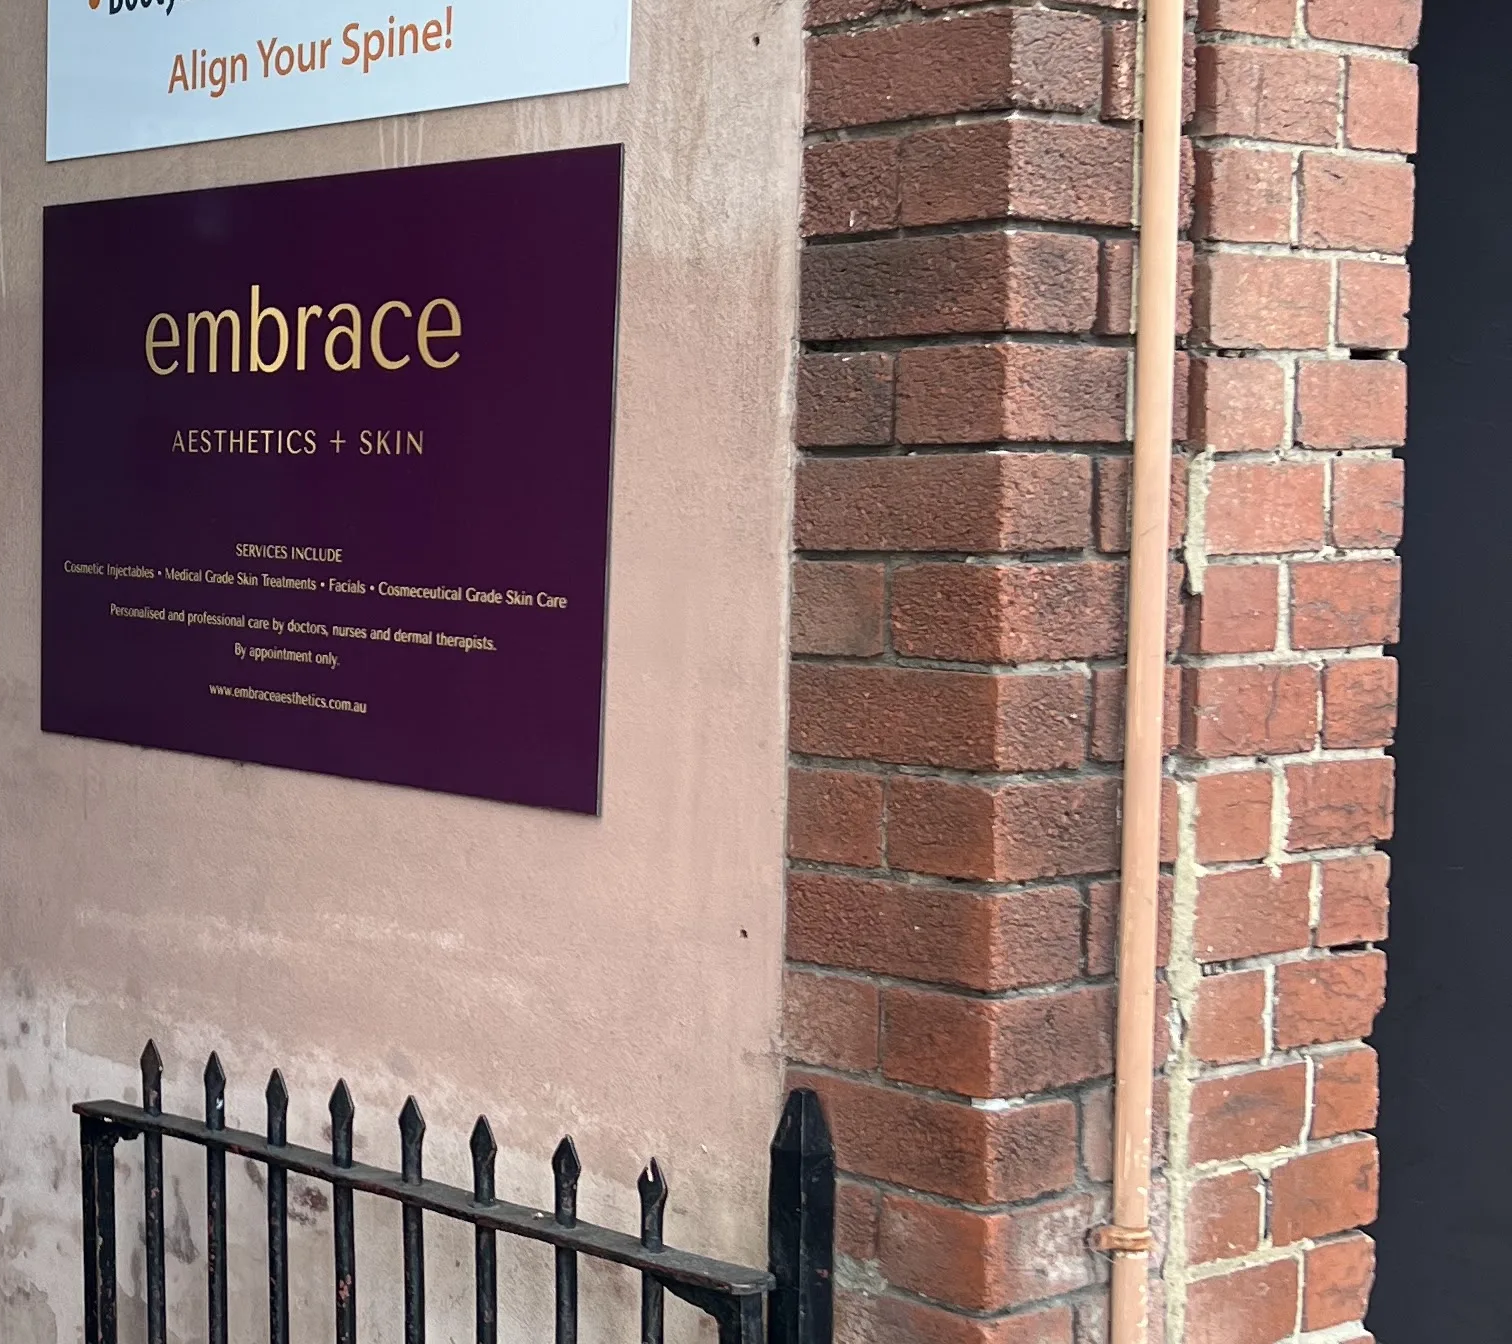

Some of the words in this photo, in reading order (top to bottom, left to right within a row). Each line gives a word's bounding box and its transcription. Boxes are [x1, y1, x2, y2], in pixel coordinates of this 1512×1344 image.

[167, 52, 248, 98] Align
[256, 35, 332, 79] Your
[341, 5, 453, 74] Spine!
[144, 284, 463, 376] embrace
[171, 429, 317, 455] AESTHETICS
[359, 429, 425, 456] SKIN
[236, 543, 288, 560] SERVICES
[291, 546, 343, 563] INCLUDE
[64, 560, 104, 575] Cosmetic
[107, 563, 155, 580] Injectables
[165, 568, 202, 582] Medical
[205, 569, 234, 585] Grade
[237, 571, 258, 586] Skin
[261, 573, 317, 591] Treatments
[328, 577, 366, 594] Facials
[378, 581, 462, 601] Cosmeceutical
[465, 587, 503, 604] Grade
[505, 589, 533, 606] Skin
[536, 592, 568, 609] Care
[110, 603, 165, 621] Personalised
[168, 609, 185, 622] and
[187, 610, 245, 628] professional
[247, 618, 269, 630] care
[272, 618, 284, 635] by
[287, 619, 329, 636] doctors,
[332, 625, 367, 639] nurses
[370, 627, 390, 641] and
[393, 628, 433, 645] dermal
[436, 632, 497, 652] therapists.
[234, 642, 247, 659] By
[249, 646, 312, 664] appointment
[315, 651, 340, 670] only.
[209, 684, 368, 714] www.embraceaesthetics.com.au
